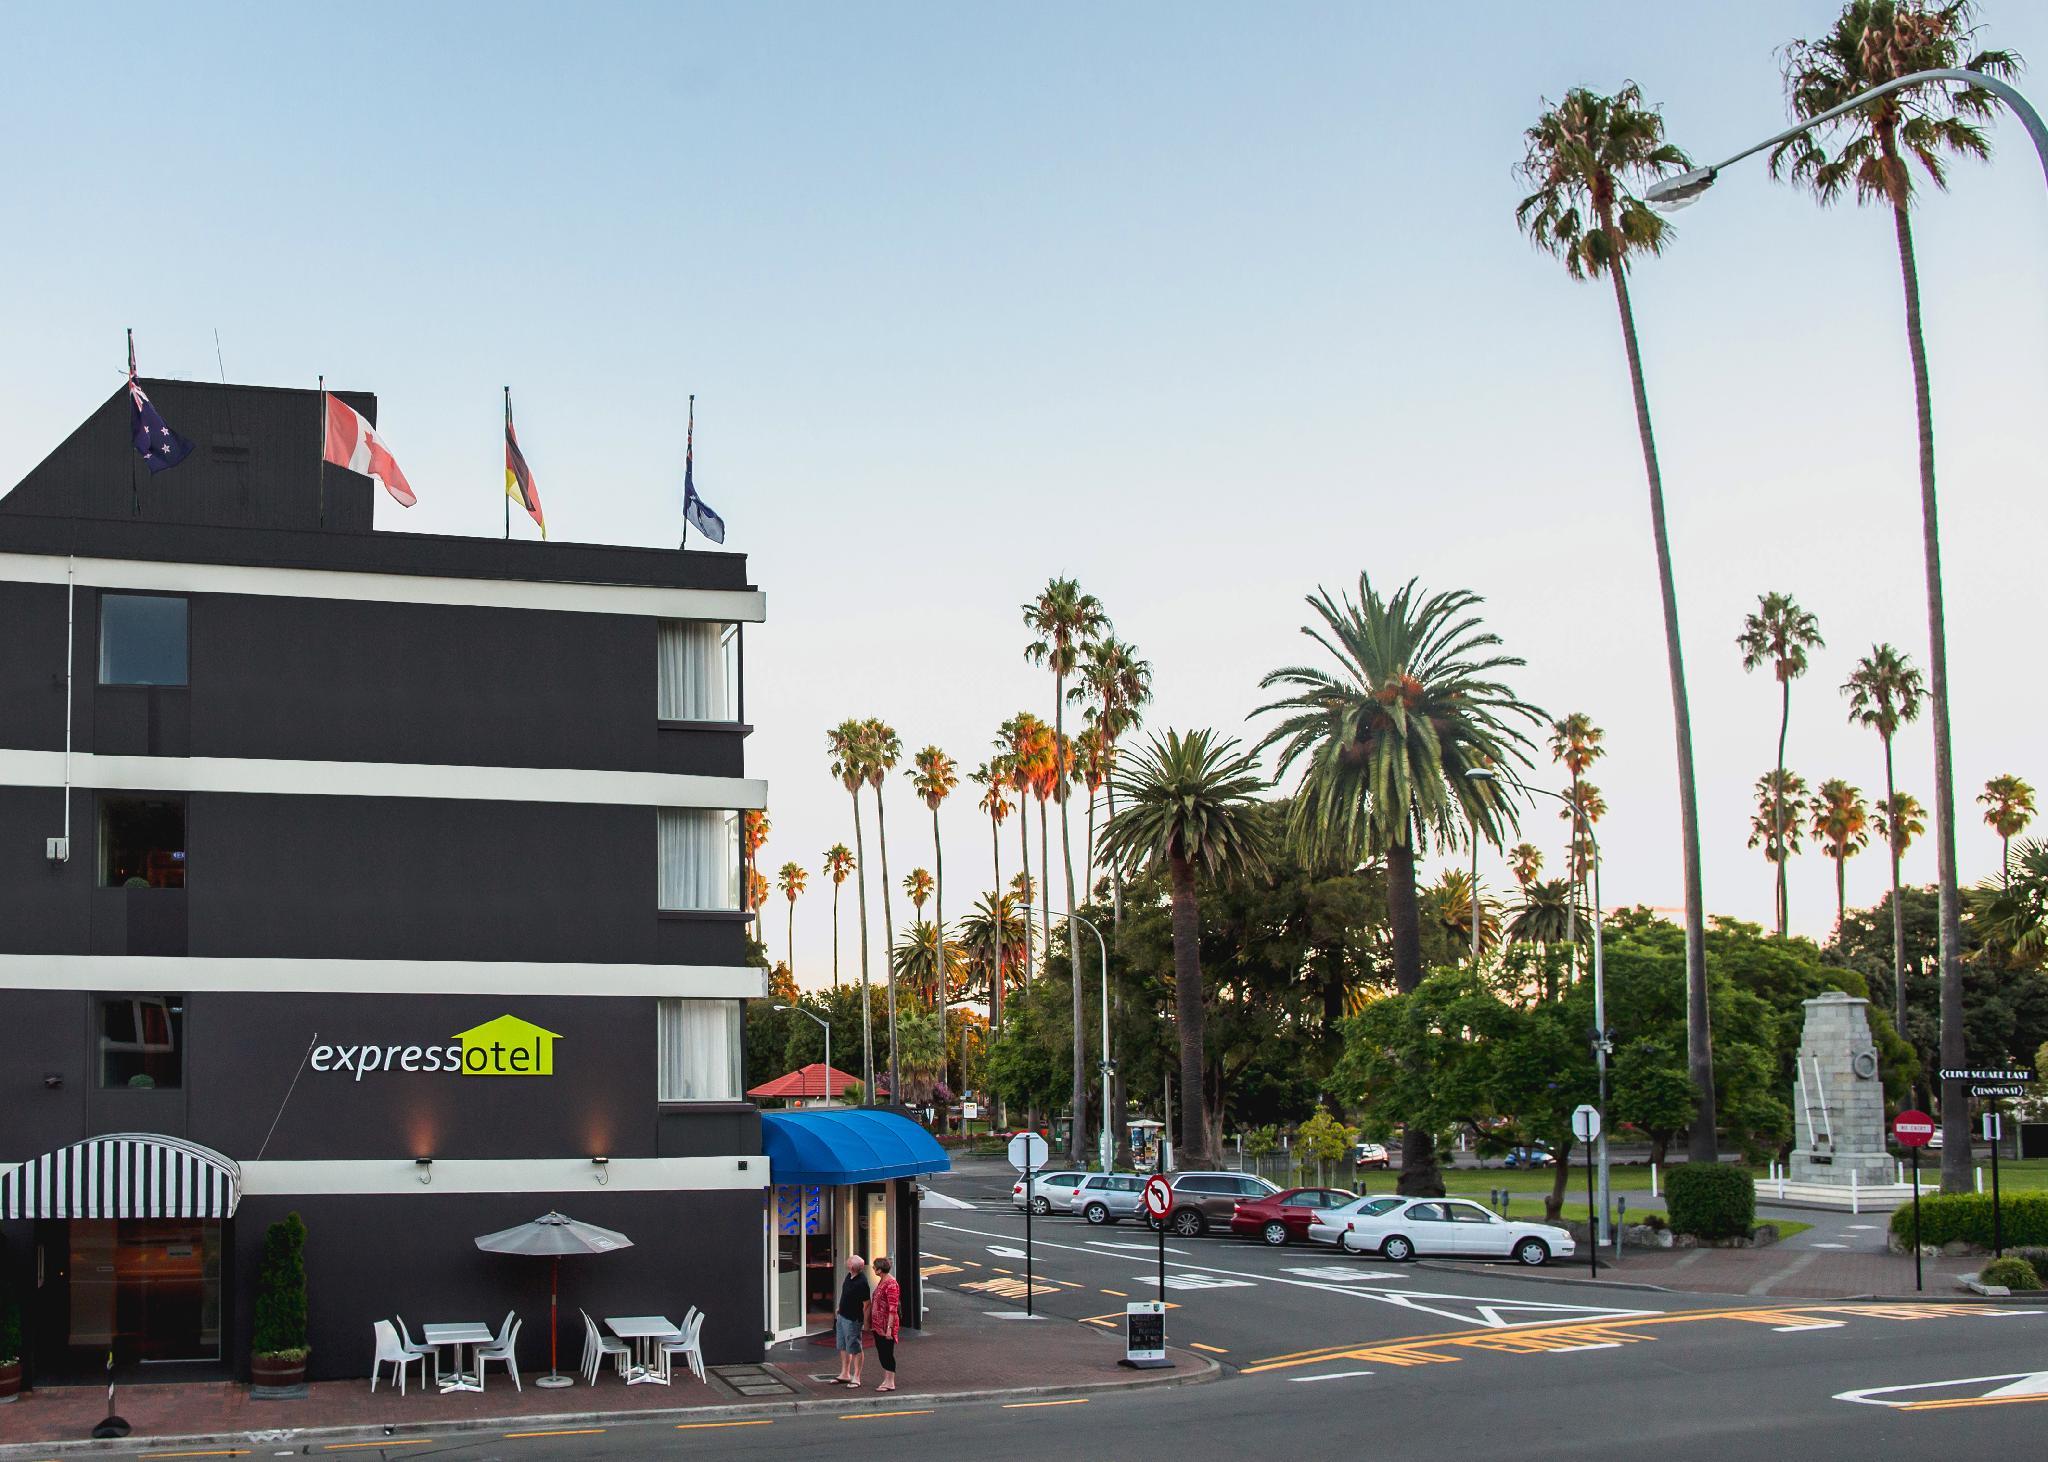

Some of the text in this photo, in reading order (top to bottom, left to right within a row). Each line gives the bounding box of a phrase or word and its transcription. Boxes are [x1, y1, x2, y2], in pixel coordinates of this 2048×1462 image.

[1945, 1070, 2029, 1079] CLIVE SQUARE EAST
[1976, 1087, 2018, 1095] TENNYSON ST
